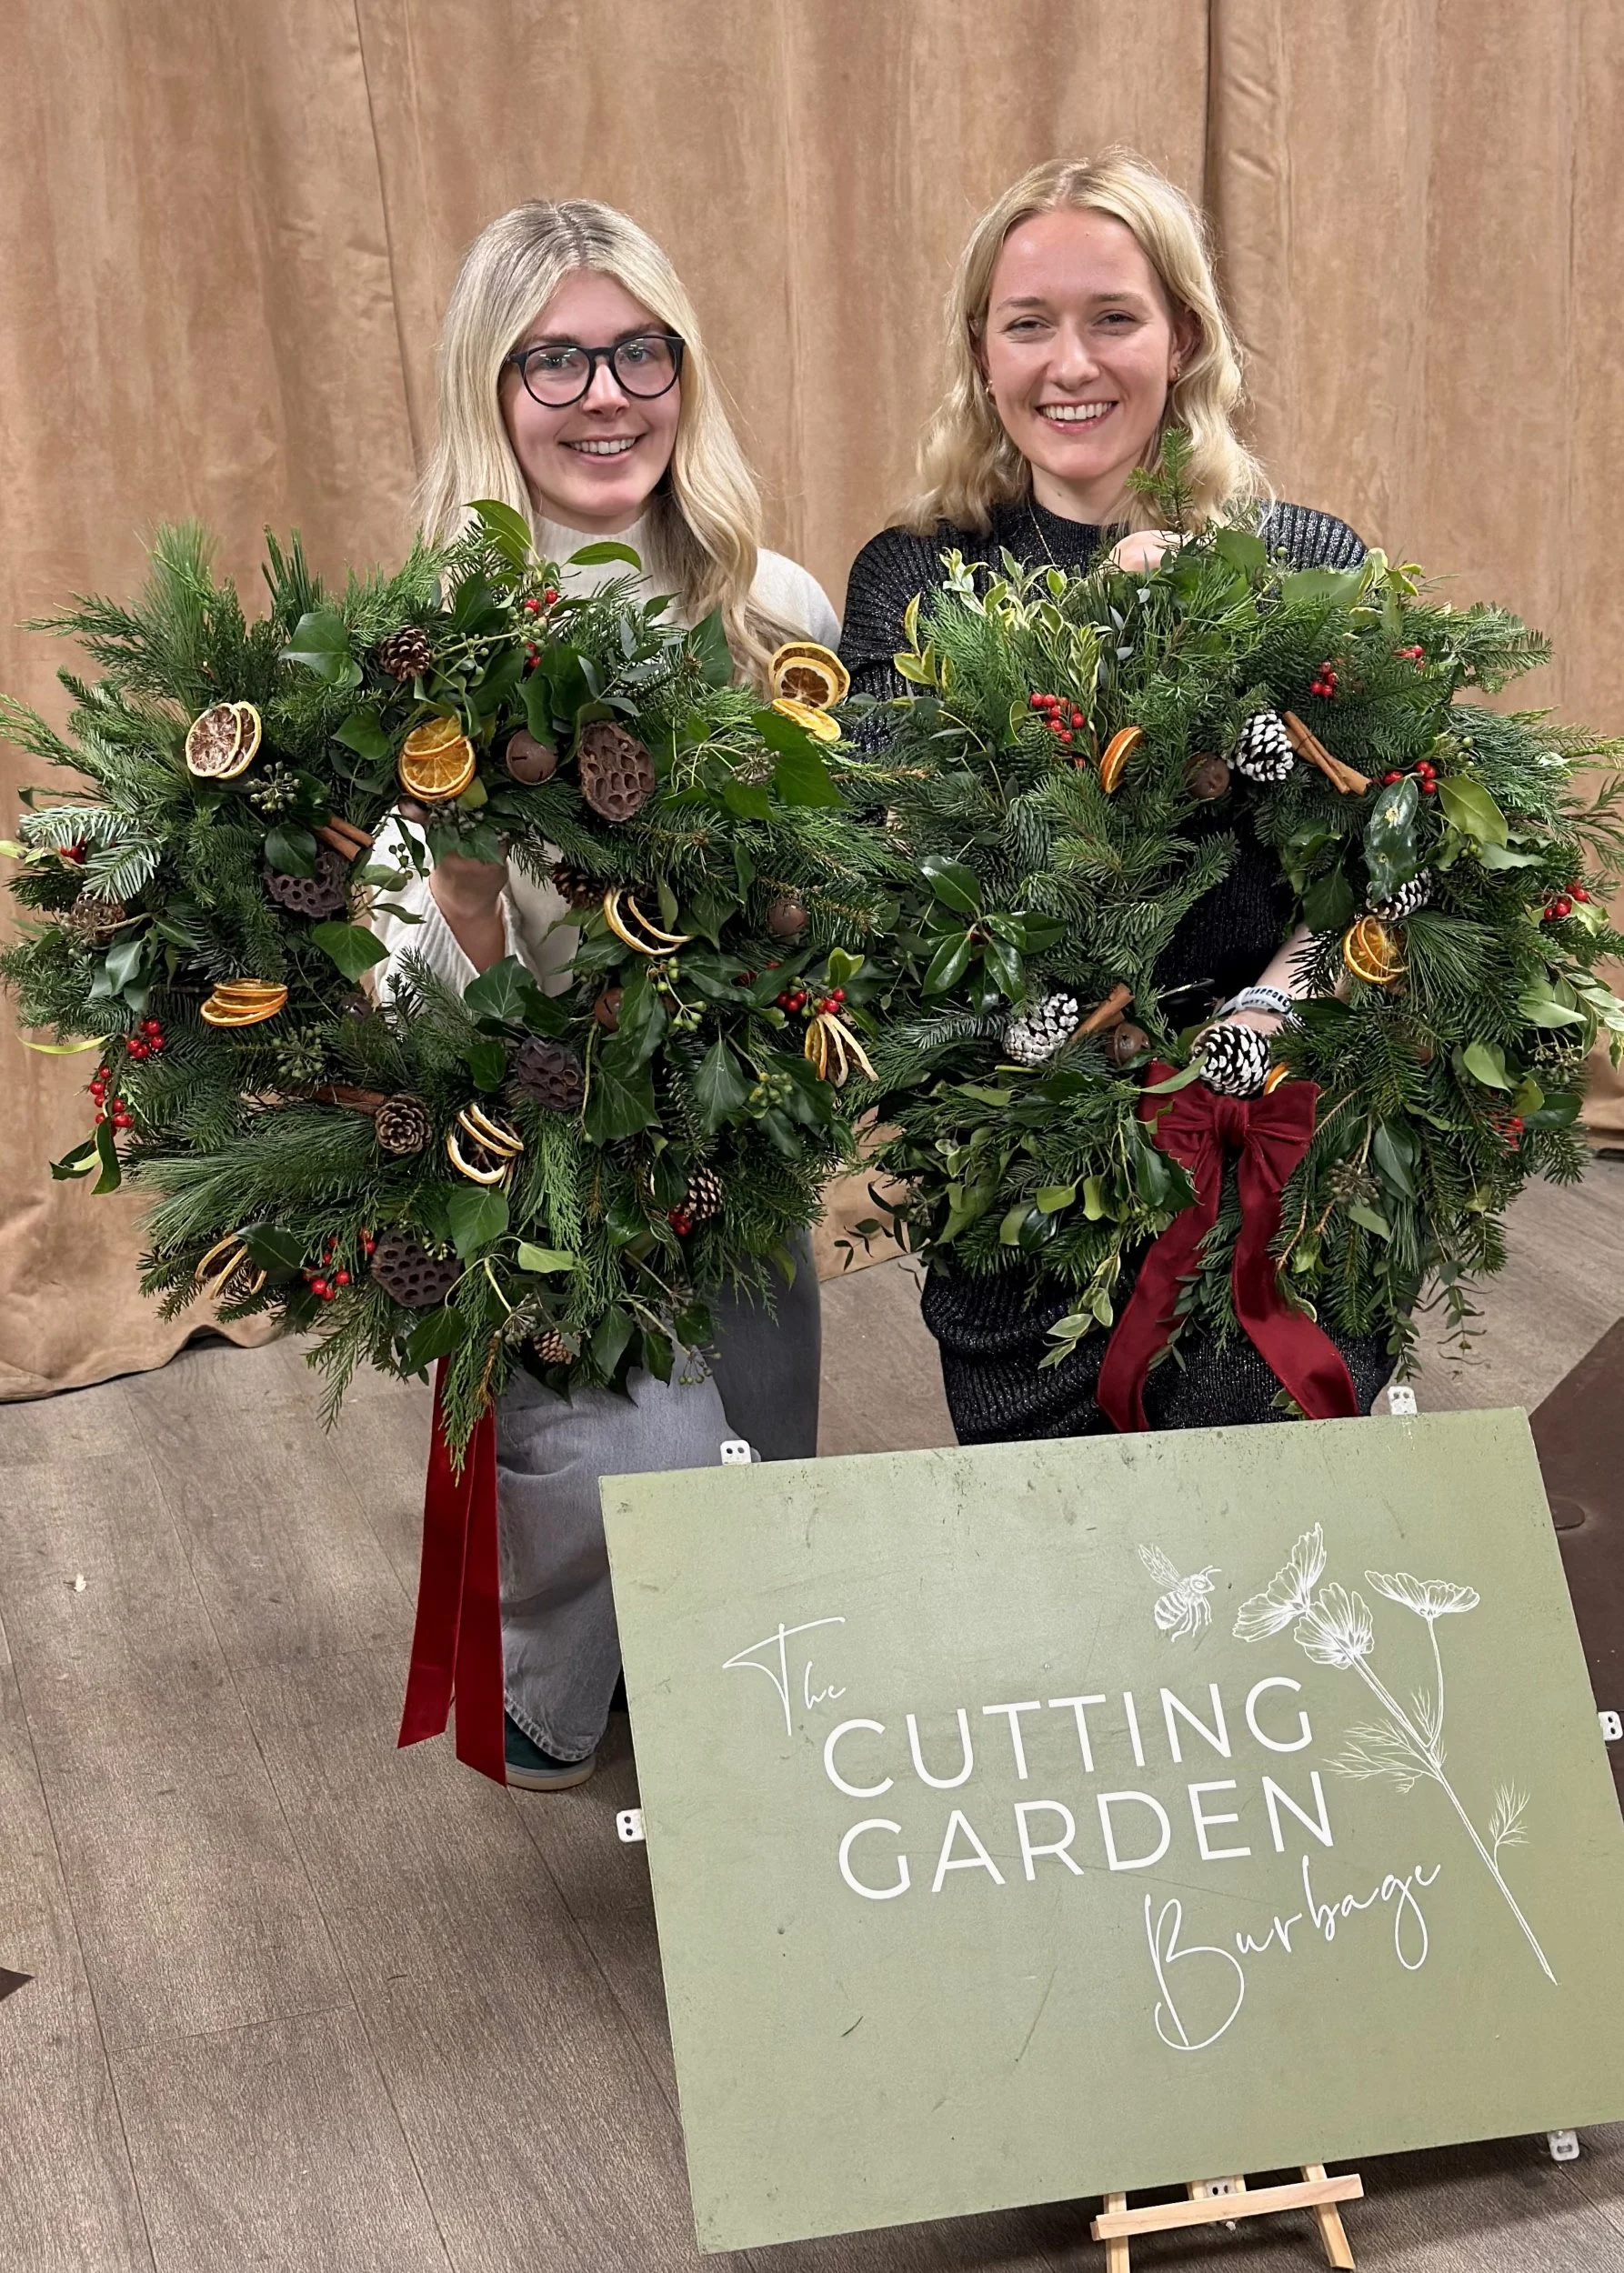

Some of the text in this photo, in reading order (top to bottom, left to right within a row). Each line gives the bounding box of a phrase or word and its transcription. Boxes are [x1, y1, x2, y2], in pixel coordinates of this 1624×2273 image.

[723, 1617, 847, 1736] The
[824, 1677, 1313, 1797] CUTTING
[839, 1771, 1334, 1899] GARDEN
[1145, 1855, 1441, 2050] Burbage
